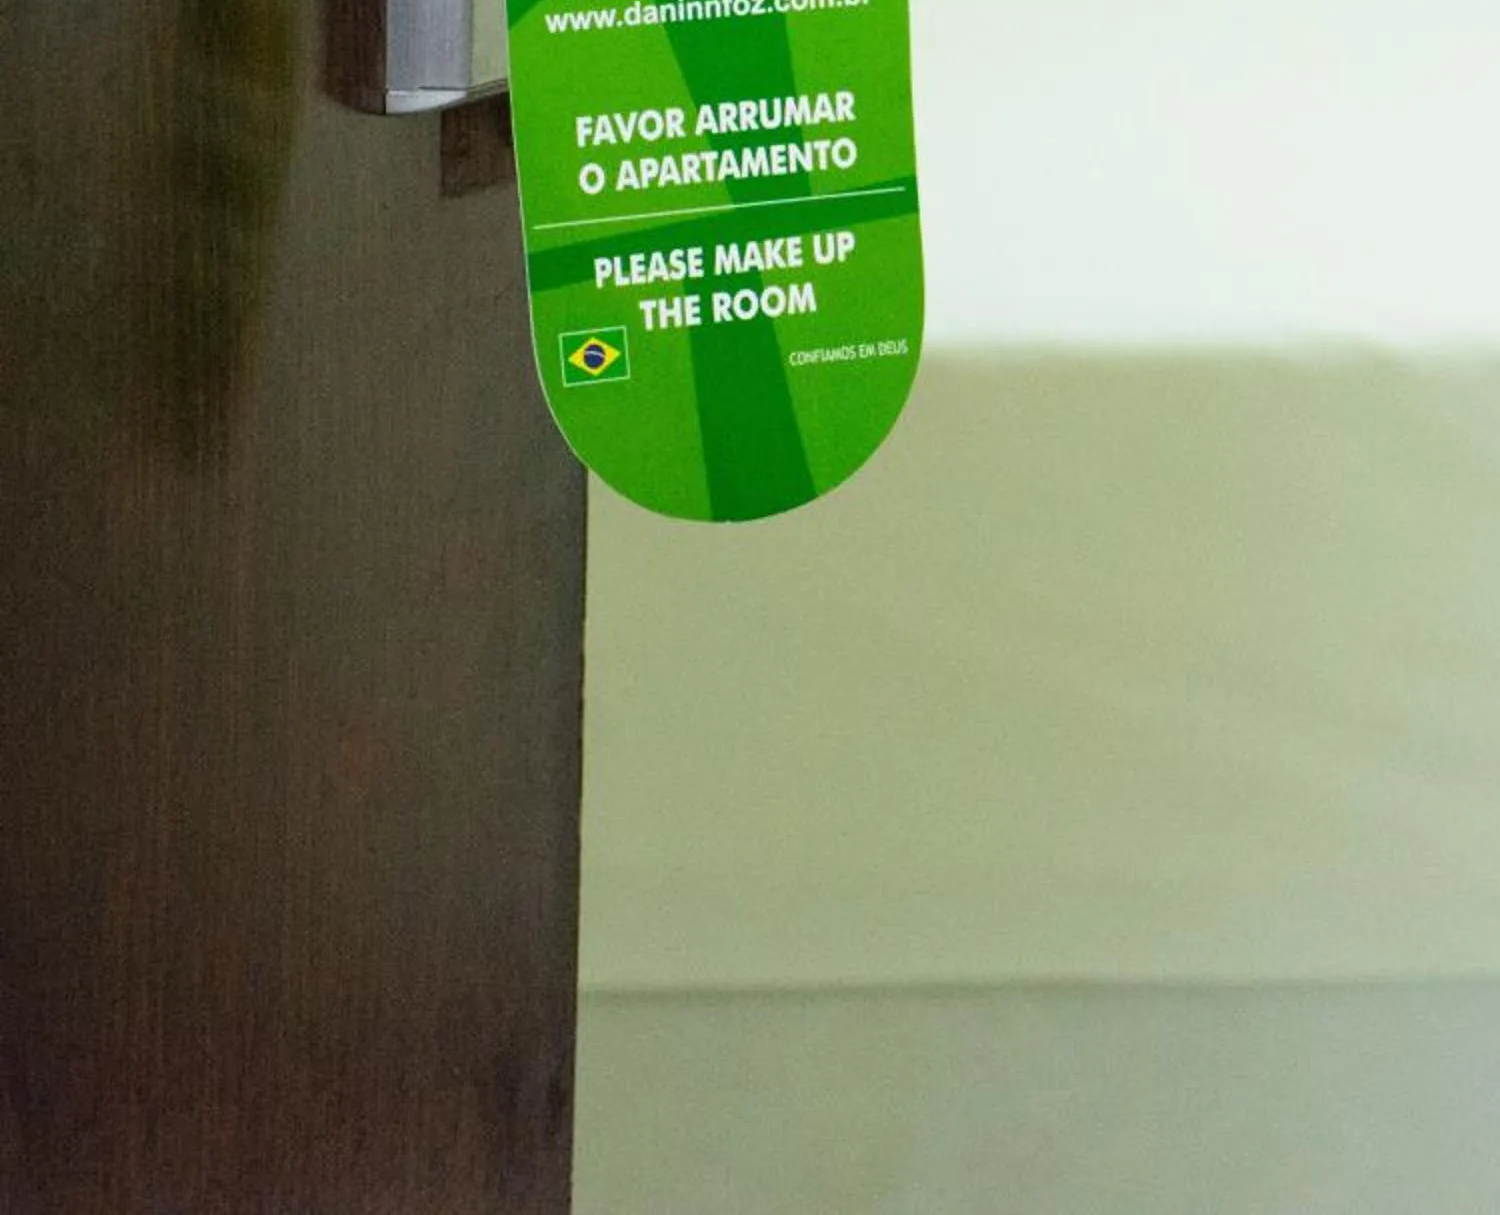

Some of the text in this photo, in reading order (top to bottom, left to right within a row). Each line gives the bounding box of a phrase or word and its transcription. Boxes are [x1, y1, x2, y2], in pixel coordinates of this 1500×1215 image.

[575, 90, 856, 148] FAVOR ARRUMAR
[579, 138, 857, 194] O APARTAMENTO
[594, 231, 856, 289] PLEASE MAKE UP
[639, 282, 816, 332] THE ROOM
[789, 338, 909, 367] CONFIAMOS EM DEUS
